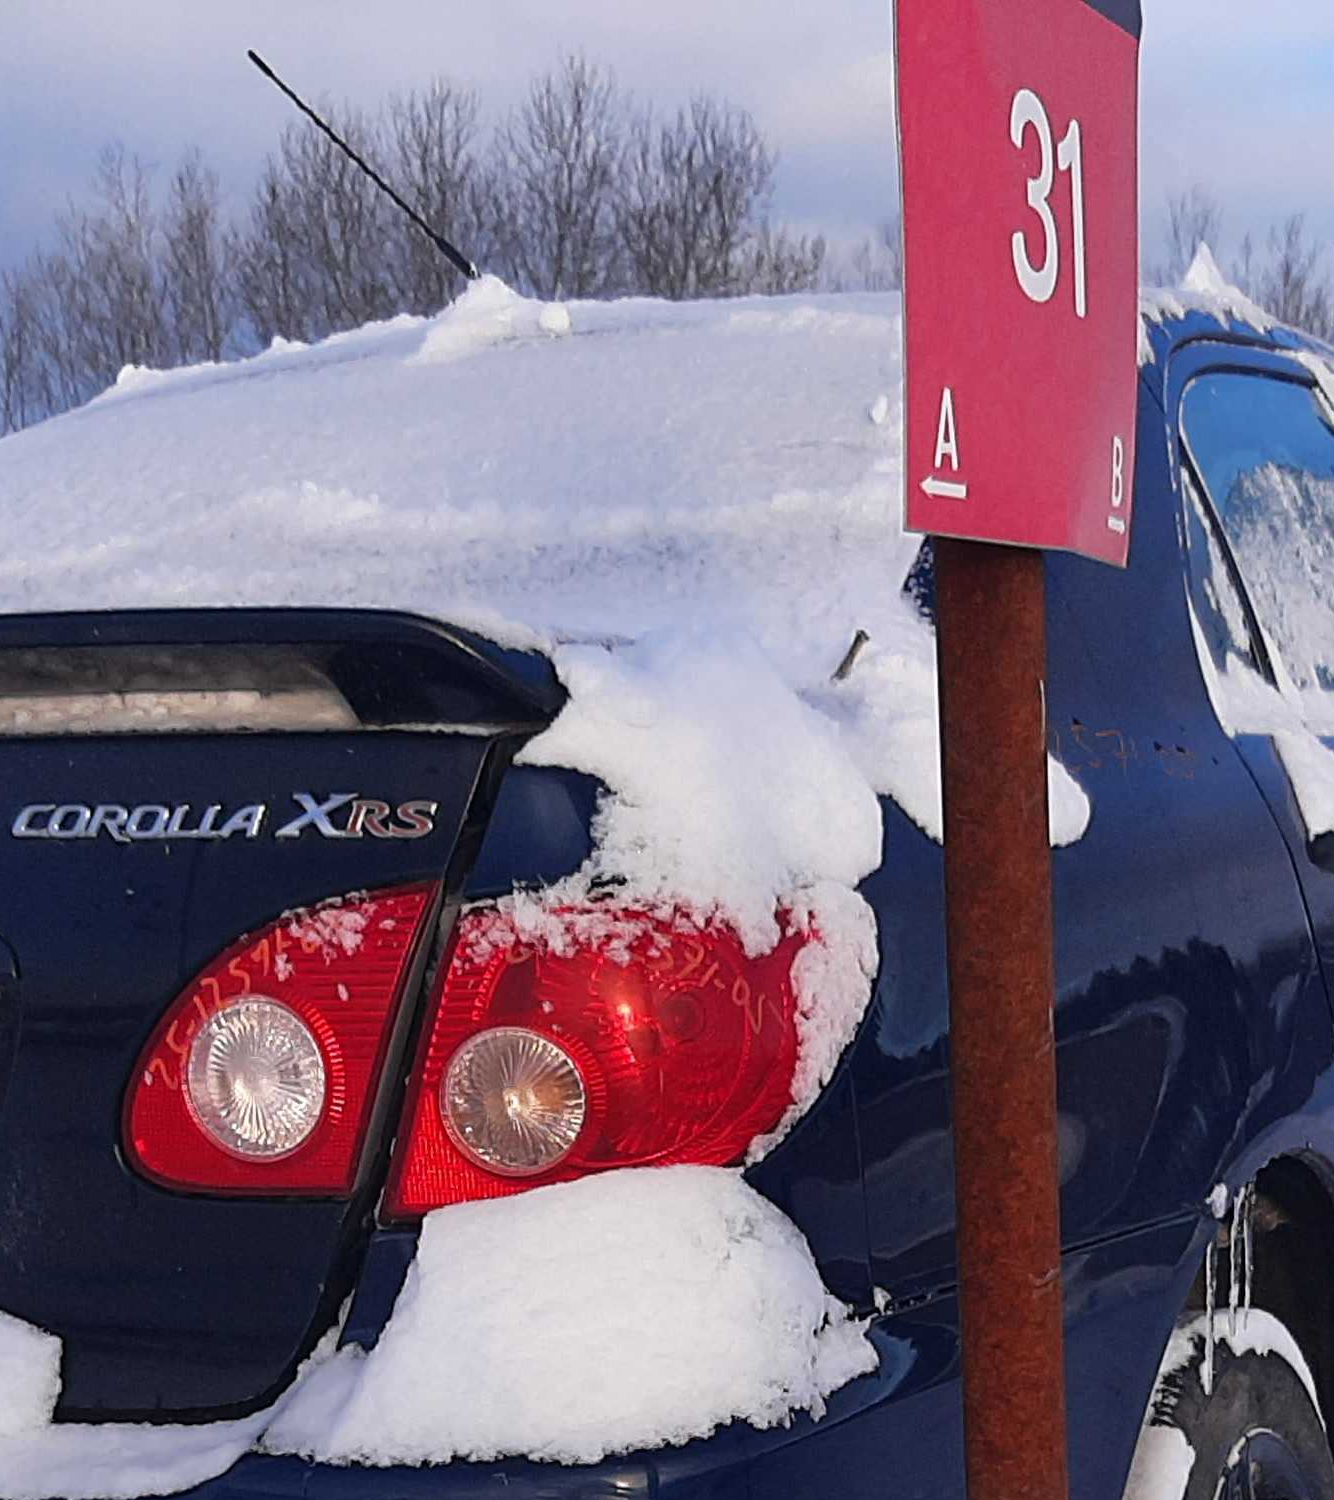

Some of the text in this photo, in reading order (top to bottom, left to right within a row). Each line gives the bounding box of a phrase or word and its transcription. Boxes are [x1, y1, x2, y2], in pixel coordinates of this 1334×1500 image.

[1009, 88, 1088, 319] 31
[934, 386, 959, 472] A
[1111, 436, 1124, 507] B
[11, 792, 438, 843] COROLLA XRS
